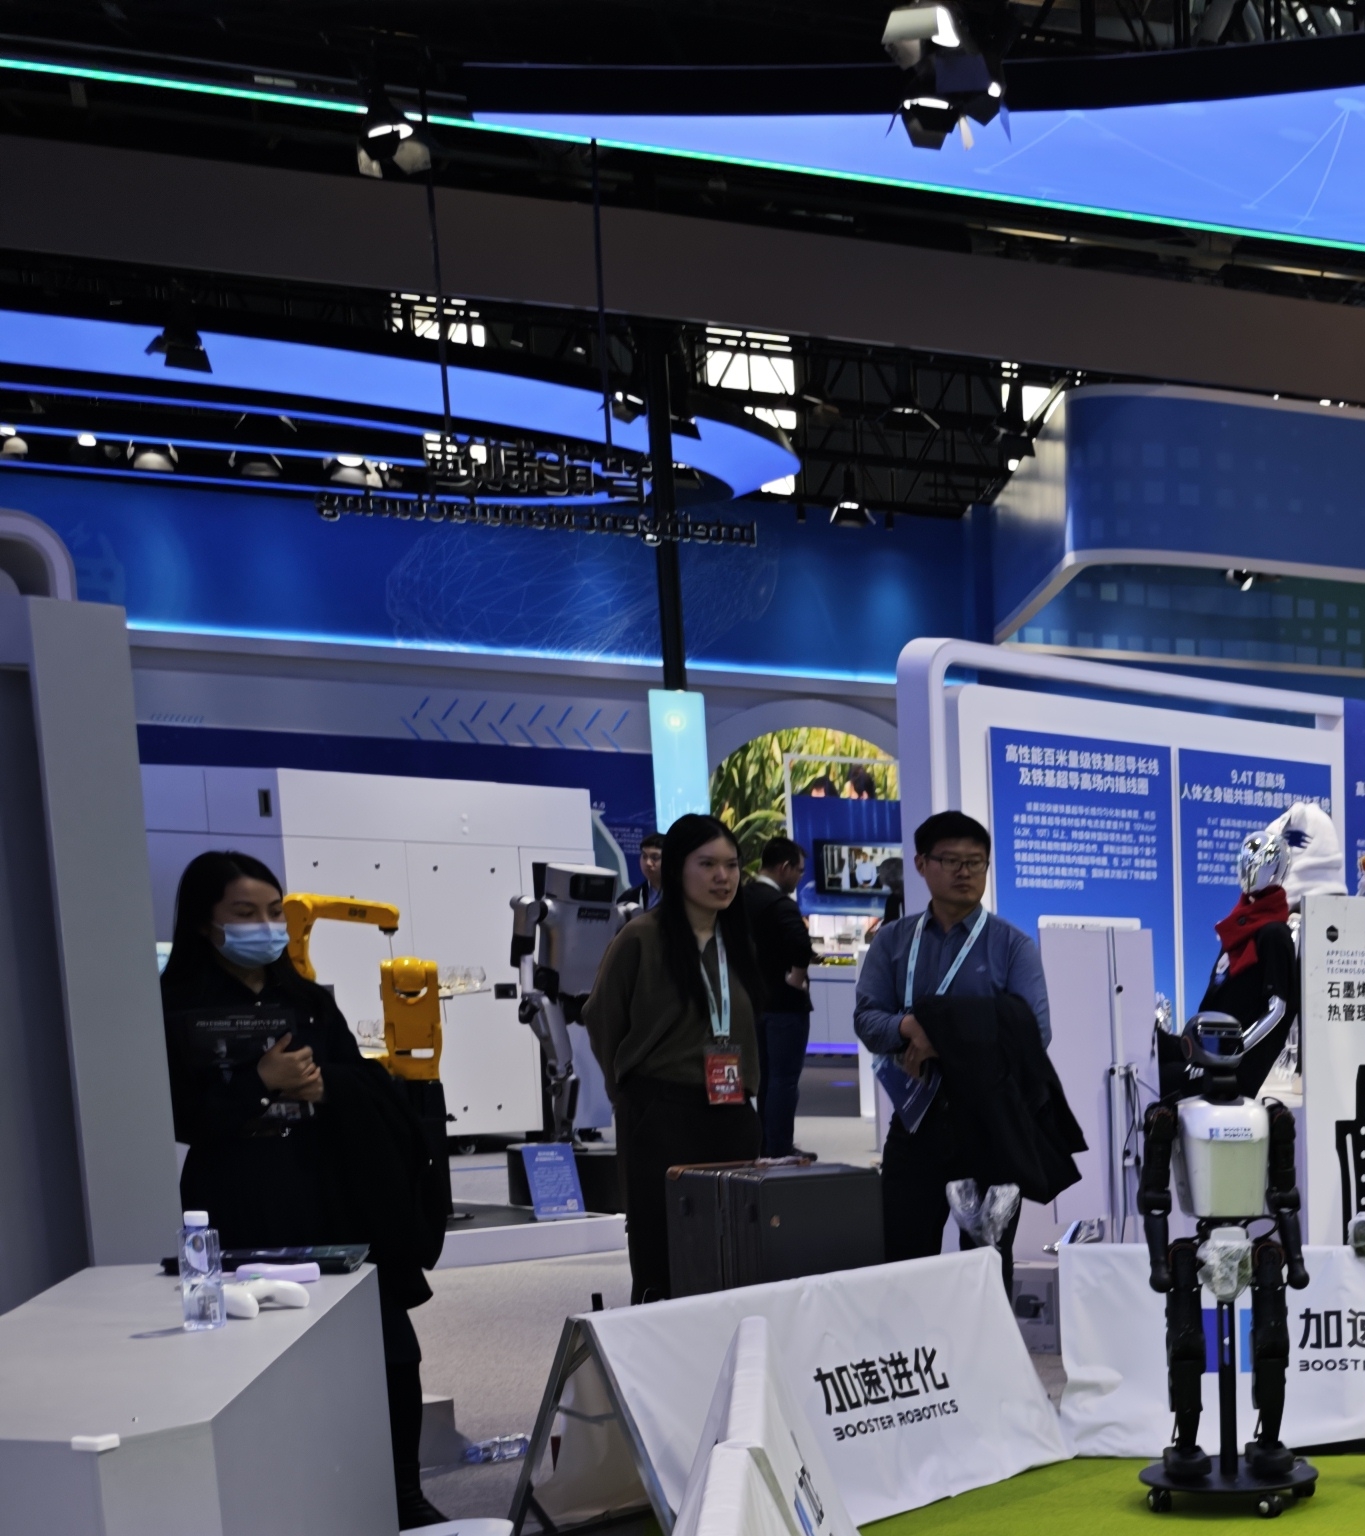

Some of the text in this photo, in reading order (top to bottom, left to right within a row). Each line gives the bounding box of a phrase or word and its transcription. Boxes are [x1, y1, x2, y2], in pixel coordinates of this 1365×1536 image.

[1005, 744, 1160, 776] 高性能百米量级铁基超导长线
[813, 1345, 950, 1417] 加速进化
[832, 1398, 959, 1442] BOOSTER ROBOTICS
